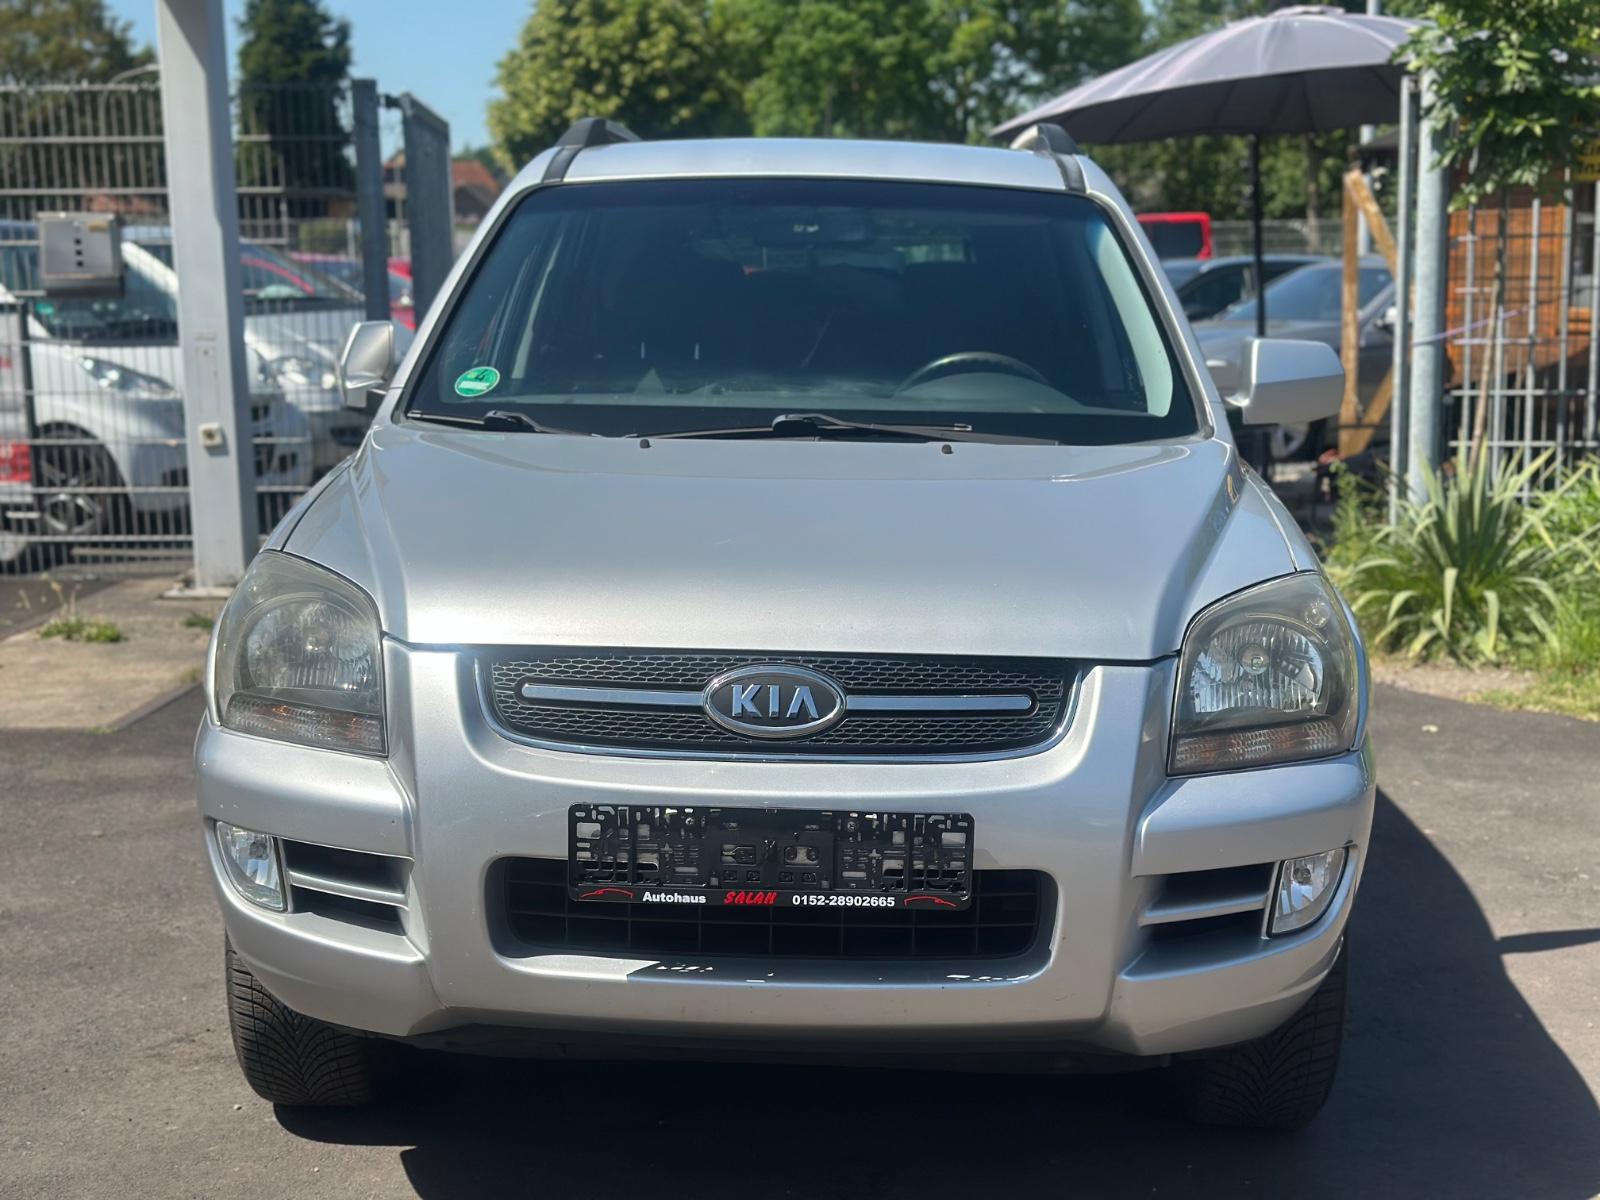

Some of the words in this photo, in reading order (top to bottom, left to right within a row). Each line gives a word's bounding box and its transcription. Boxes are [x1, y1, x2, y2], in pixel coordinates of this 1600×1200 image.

[731, 683, 820, 719] KIA
[642, 891, 707, 904] Autohaus
[723, 891, 777, 905] SALAH
[792, 894, 896, 908] 0152-28902665
